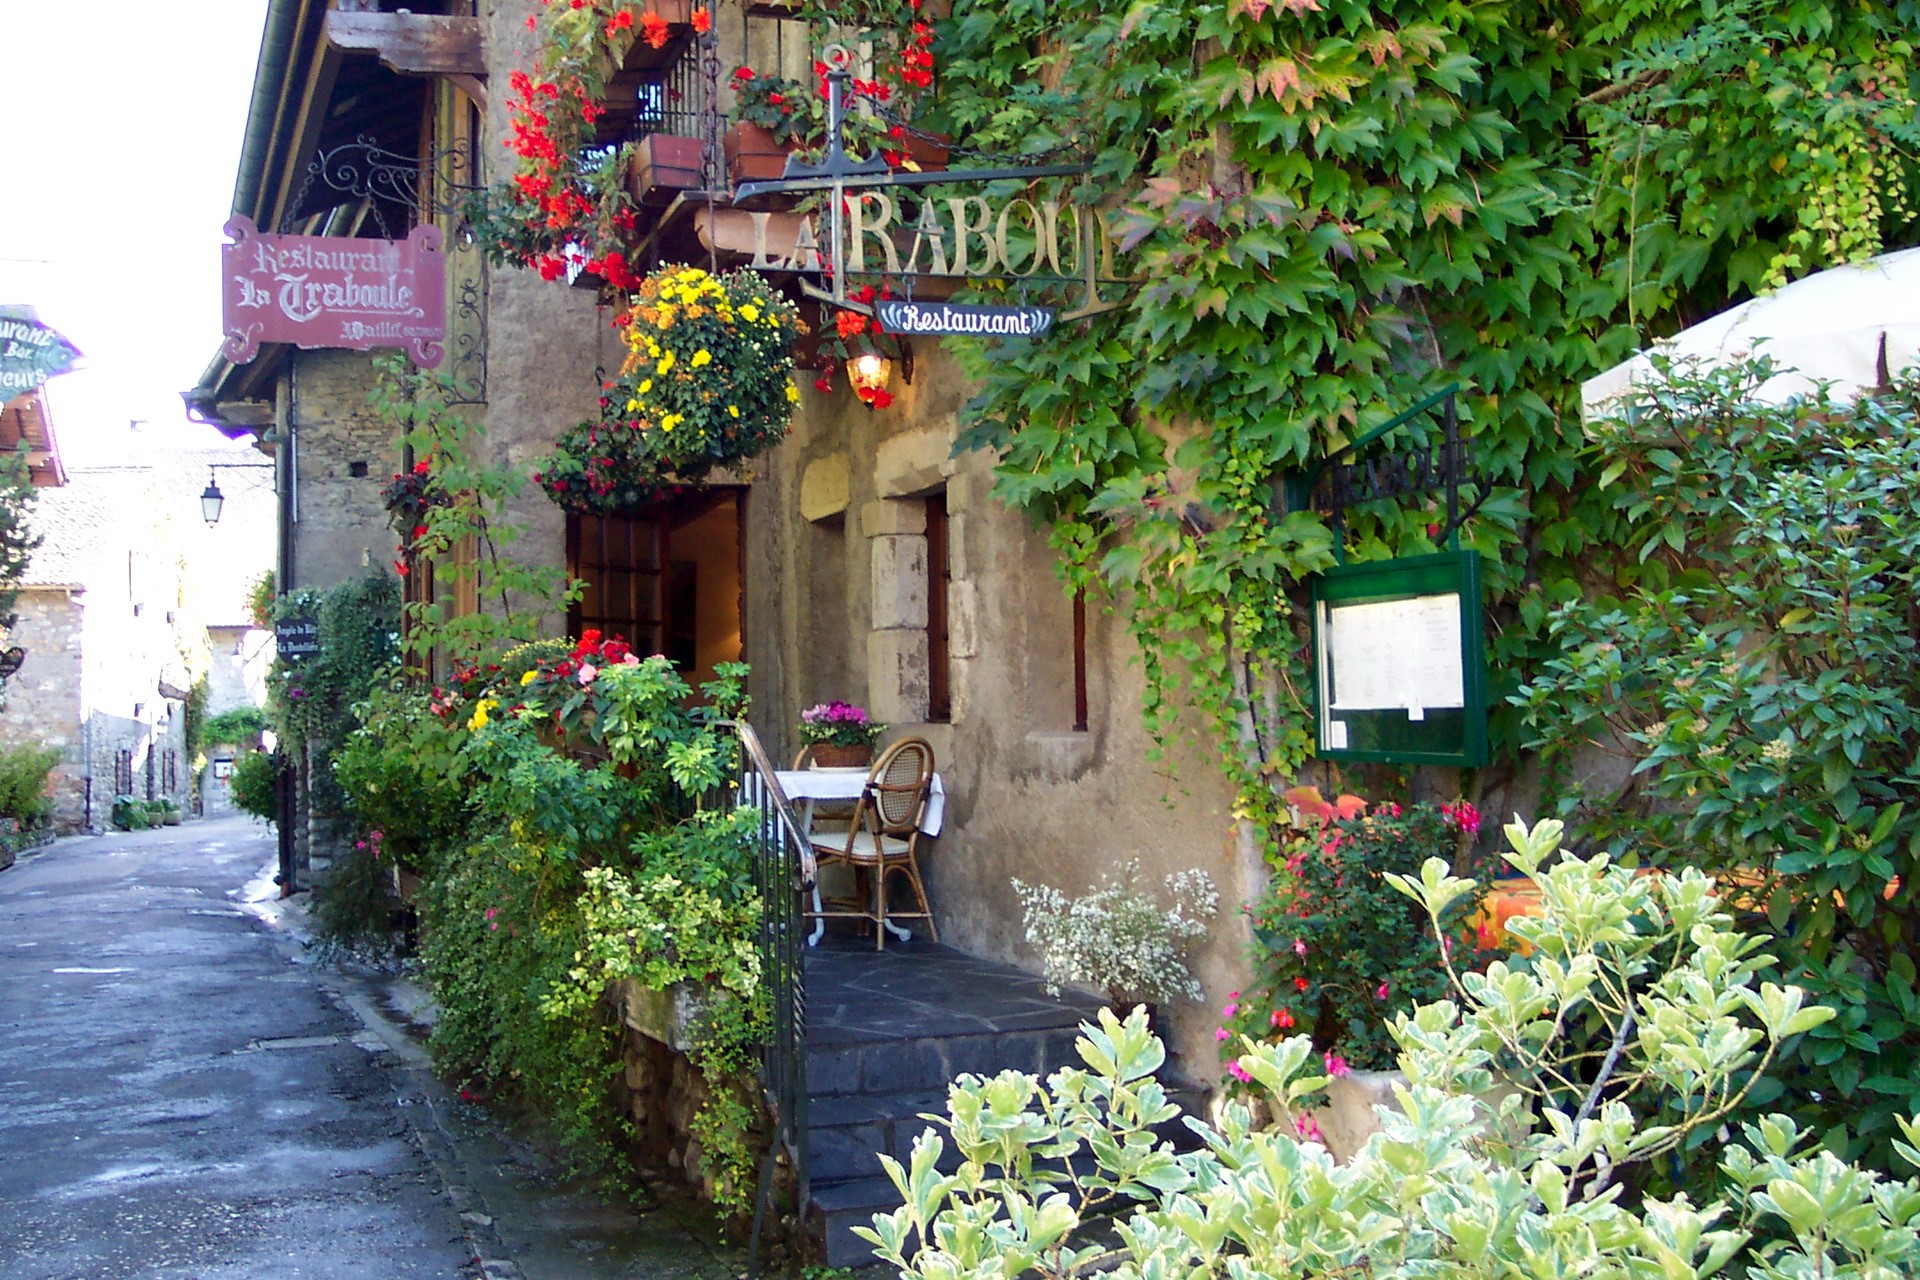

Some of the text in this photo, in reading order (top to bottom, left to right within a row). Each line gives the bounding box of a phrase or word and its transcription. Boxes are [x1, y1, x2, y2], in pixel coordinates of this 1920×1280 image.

[250, 241, 402, 274] Restaurant
[233, 272, 412, 322] La Traboule
[902, 305, 1031, 335] Restaurant
[4, 341, 35, 360] Bar
